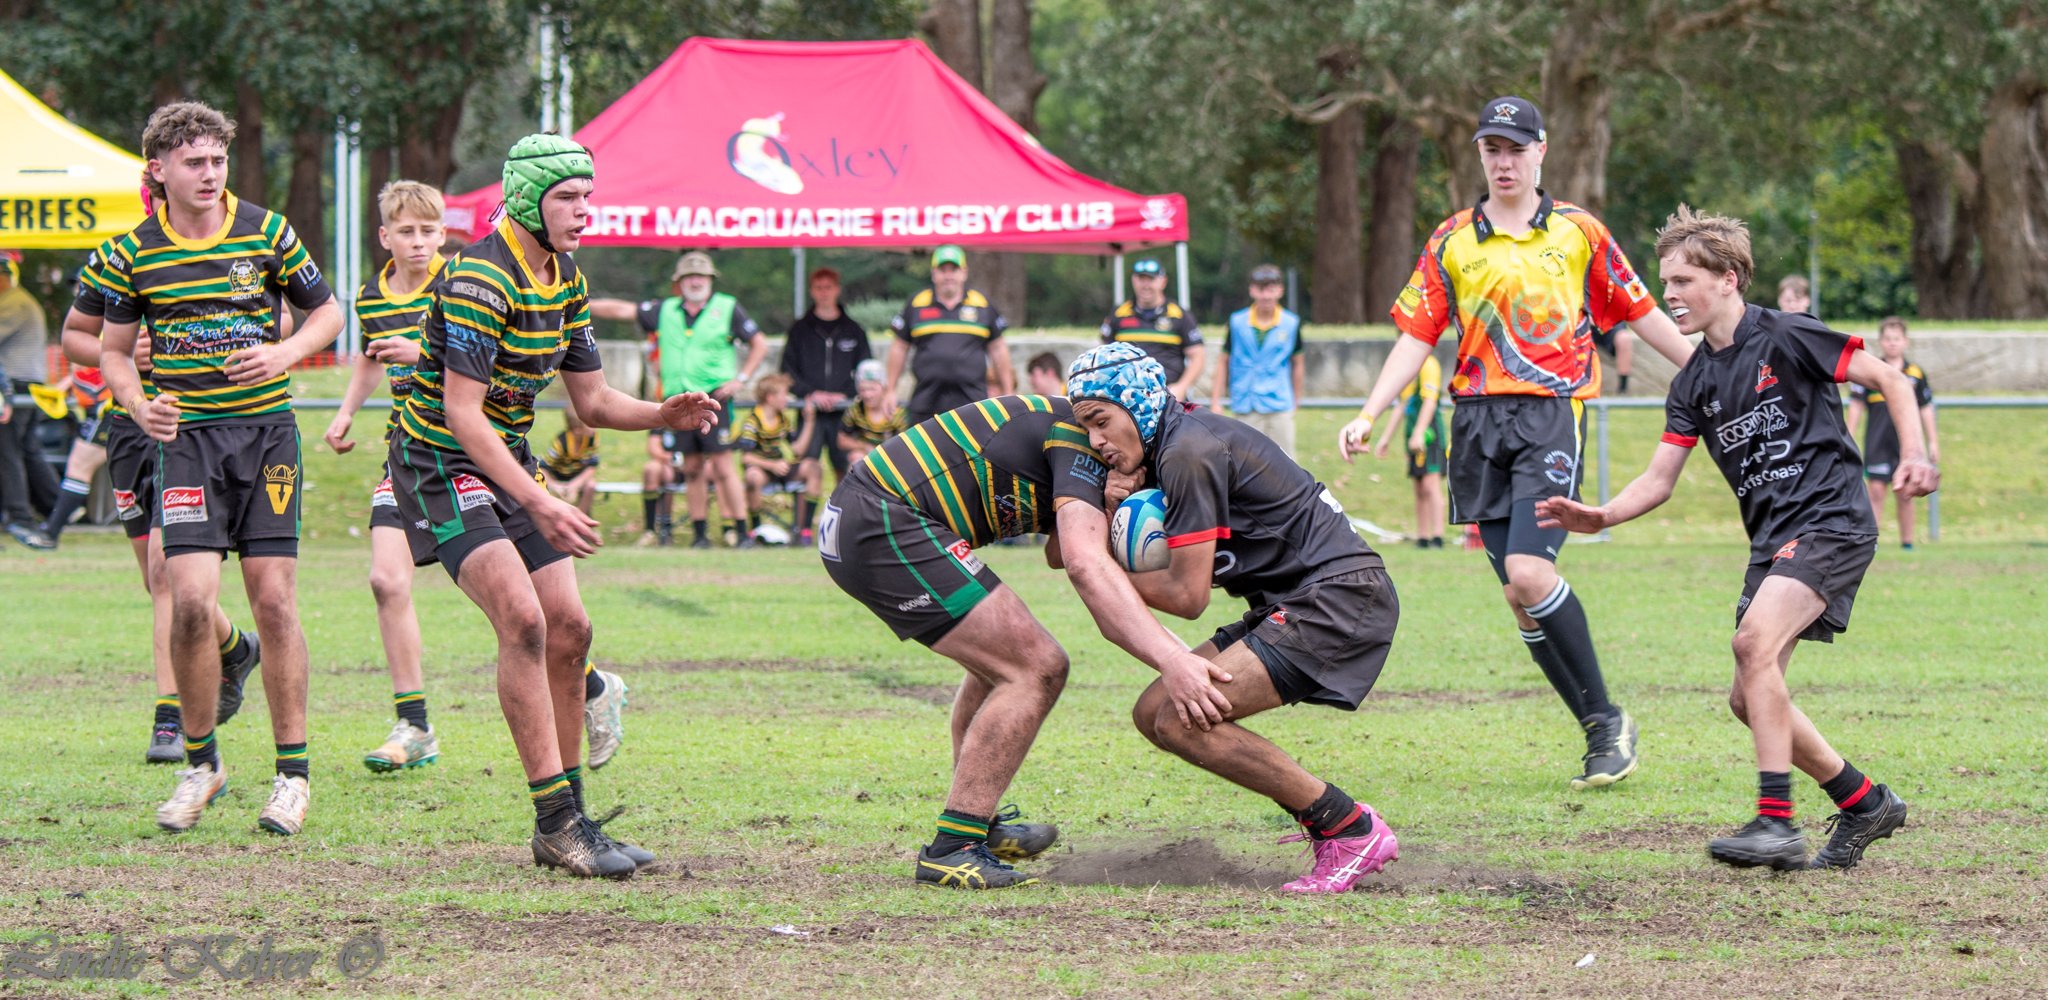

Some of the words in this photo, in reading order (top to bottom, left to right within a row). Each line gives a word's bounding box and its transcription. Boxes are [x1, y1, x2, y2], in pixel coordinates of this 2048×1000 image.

[579, 205, 649, 237] ORT
[655, 205, 875, 238] MACQUARIE
[881, 203, 1010, 237] RUGBY
[1016, 201, 1115, 233] CLUB
[165, 508, 202, 518] Insurance
